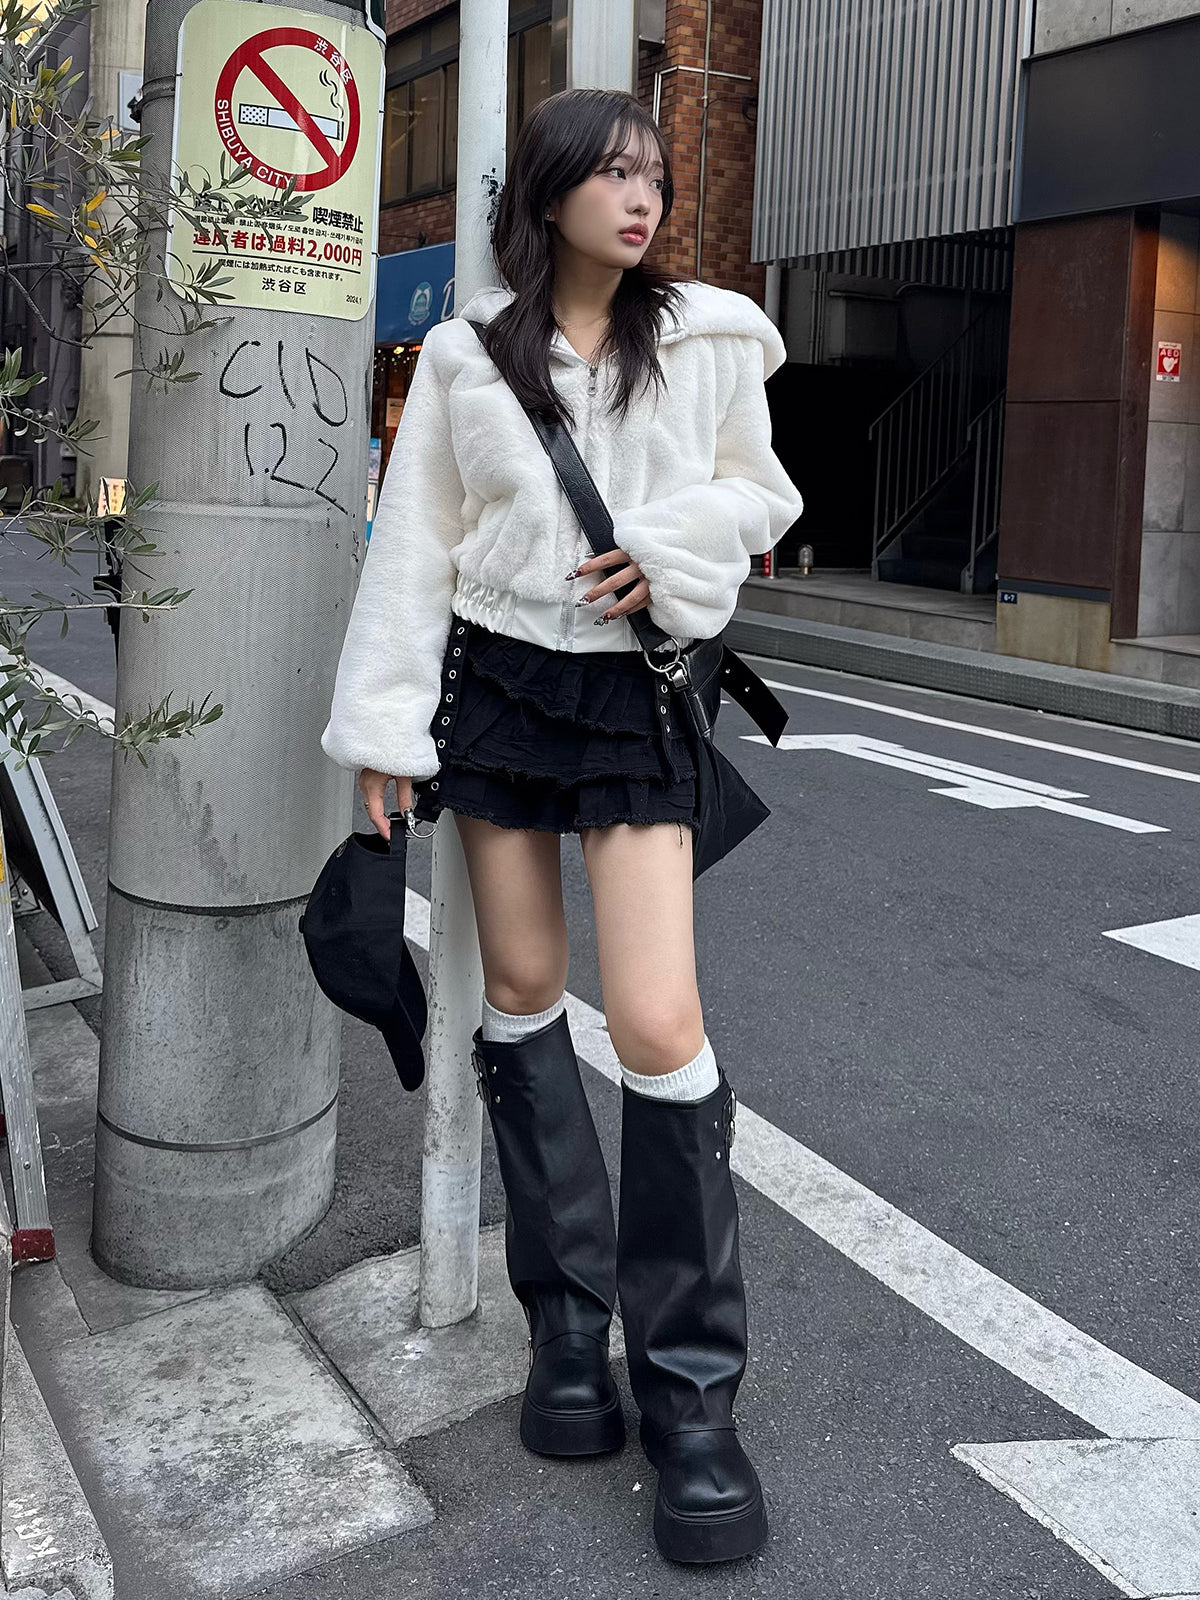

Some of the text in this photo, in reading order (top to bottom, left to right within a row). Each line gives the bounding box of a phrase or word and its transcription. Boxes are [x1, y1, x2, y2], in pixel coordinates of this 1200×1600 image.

[314, 37, 353, 85] 渋谷区
[217, 99, 294, 188] SHIBUYA CITY
[312, 206, 364, 234] 喫煙禁止
[193, 228, 362, 267] 違反者は過料2,000円
[261, 276, 307, 296] 渋谷区
[1160, 347, 1180, 358] AED
